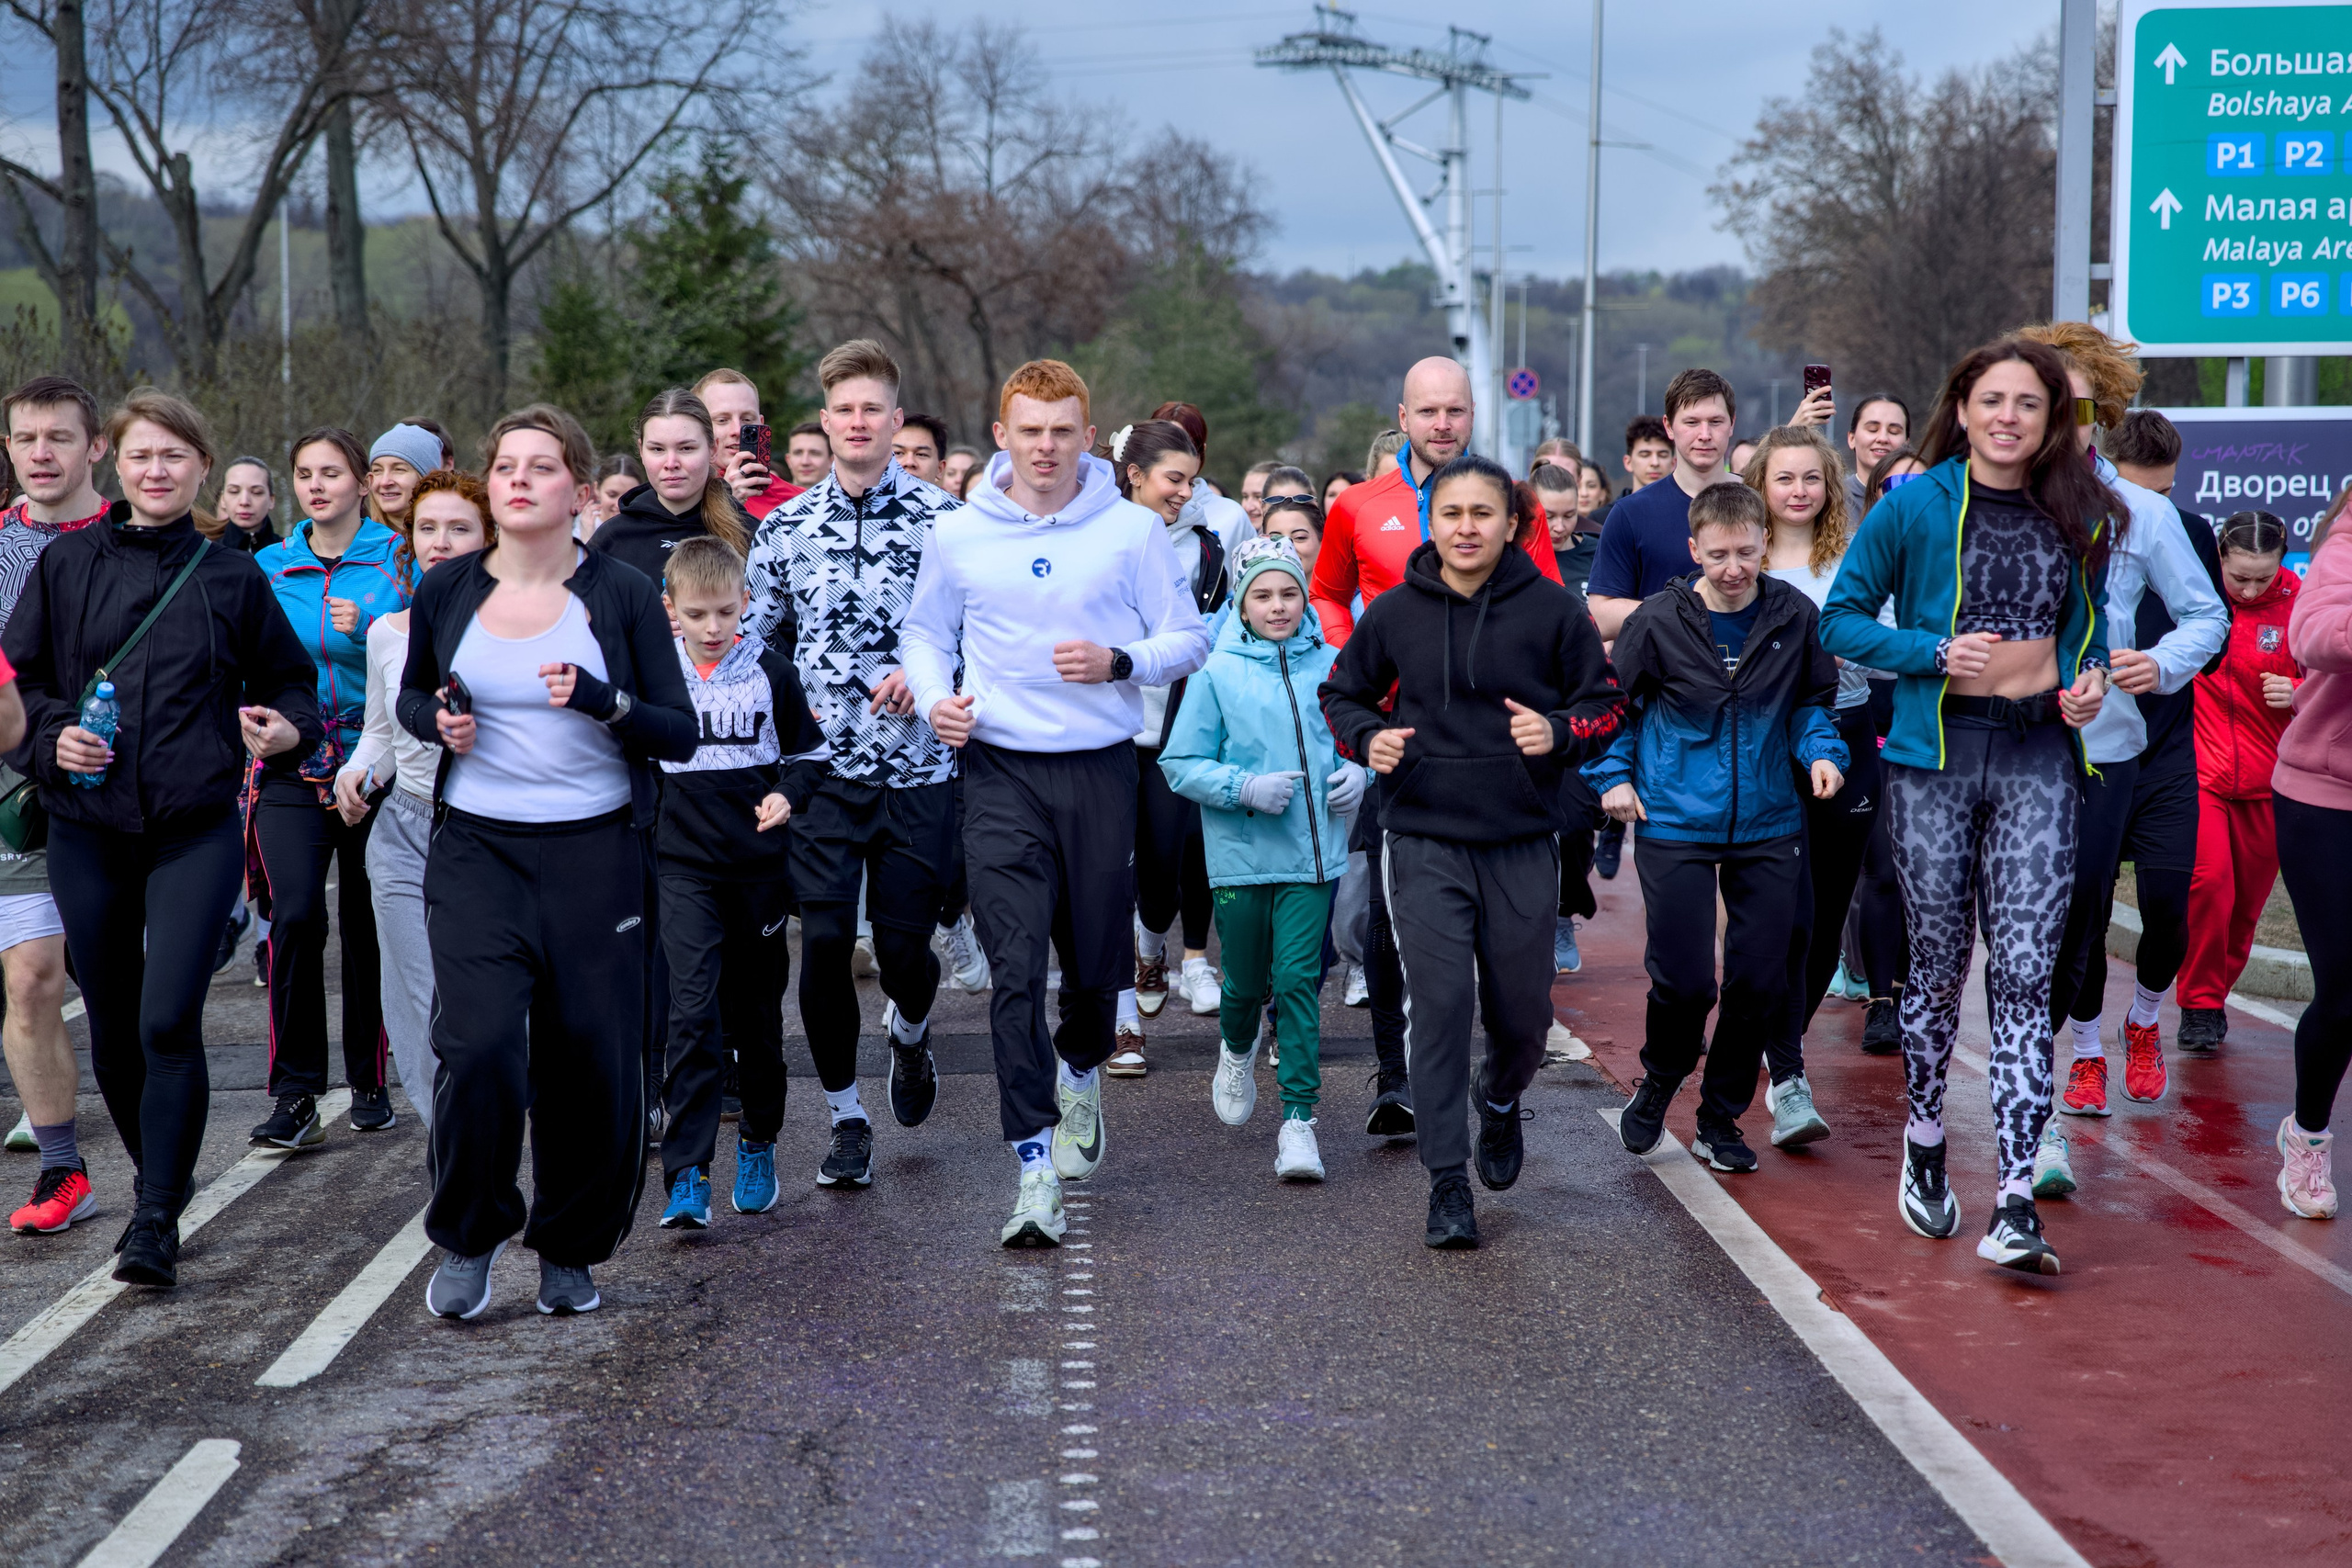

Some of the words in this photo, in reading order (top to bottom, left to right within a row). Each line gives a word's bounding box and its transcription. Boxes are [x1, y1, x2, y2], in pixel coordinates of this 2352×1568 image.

[2207, 90, 2332, 121] Bolshaya
[2216, 141, 2256, 169] P1
[2285, 141, 2324, 168] P2
[2204, 194, 2317, 221] Малая
[2327, 197, 2352, 227] а
[2203, 235, 2303, 266] Malaya
[2212, 281, 2251, 310] P3
[2281, 281, 2320, 309] P6
[2195, 470, 2332, 504] Дворец
